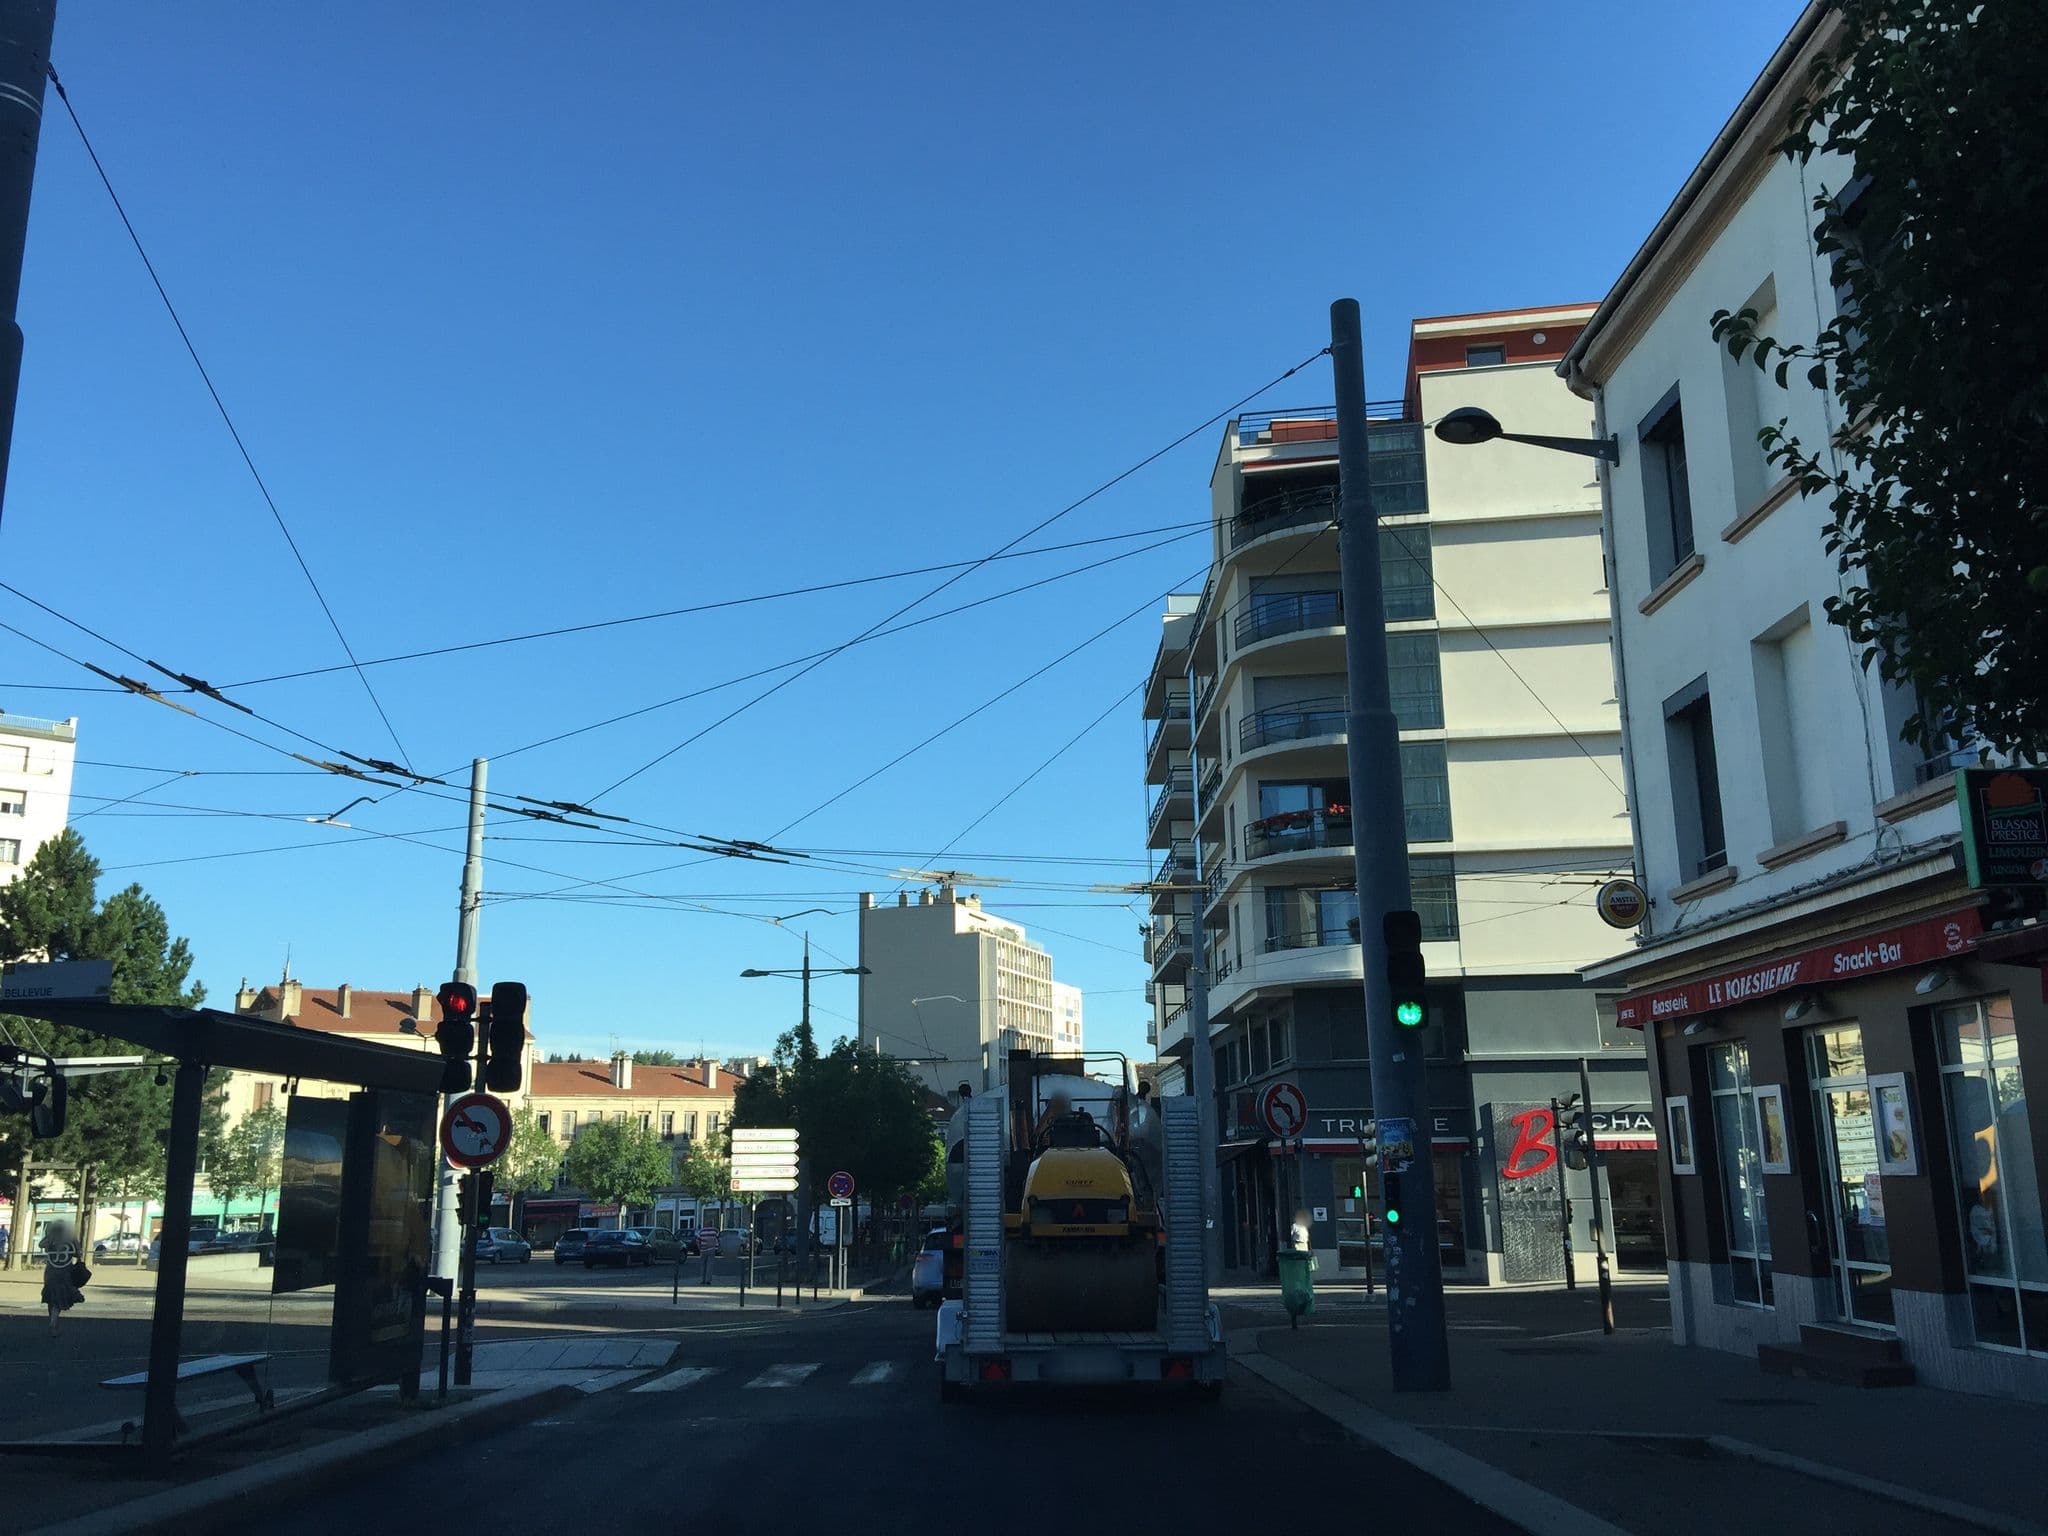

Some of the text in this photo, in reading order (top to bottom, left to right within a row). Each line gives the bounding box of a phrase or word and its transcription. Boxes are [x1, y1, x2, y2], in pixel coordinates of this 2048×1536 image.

[1991, 819, 2039, 830] BLASON
[1991, 829, 2041, 841] PRESTIGE
[1610, 896, 1637, 904] AMSTEL
[1708, 983, 1722, 1004] LE
[1833, 942, 1902, 974] Snack-Bar
[4, 986, 53, 998] BELLEVUE
